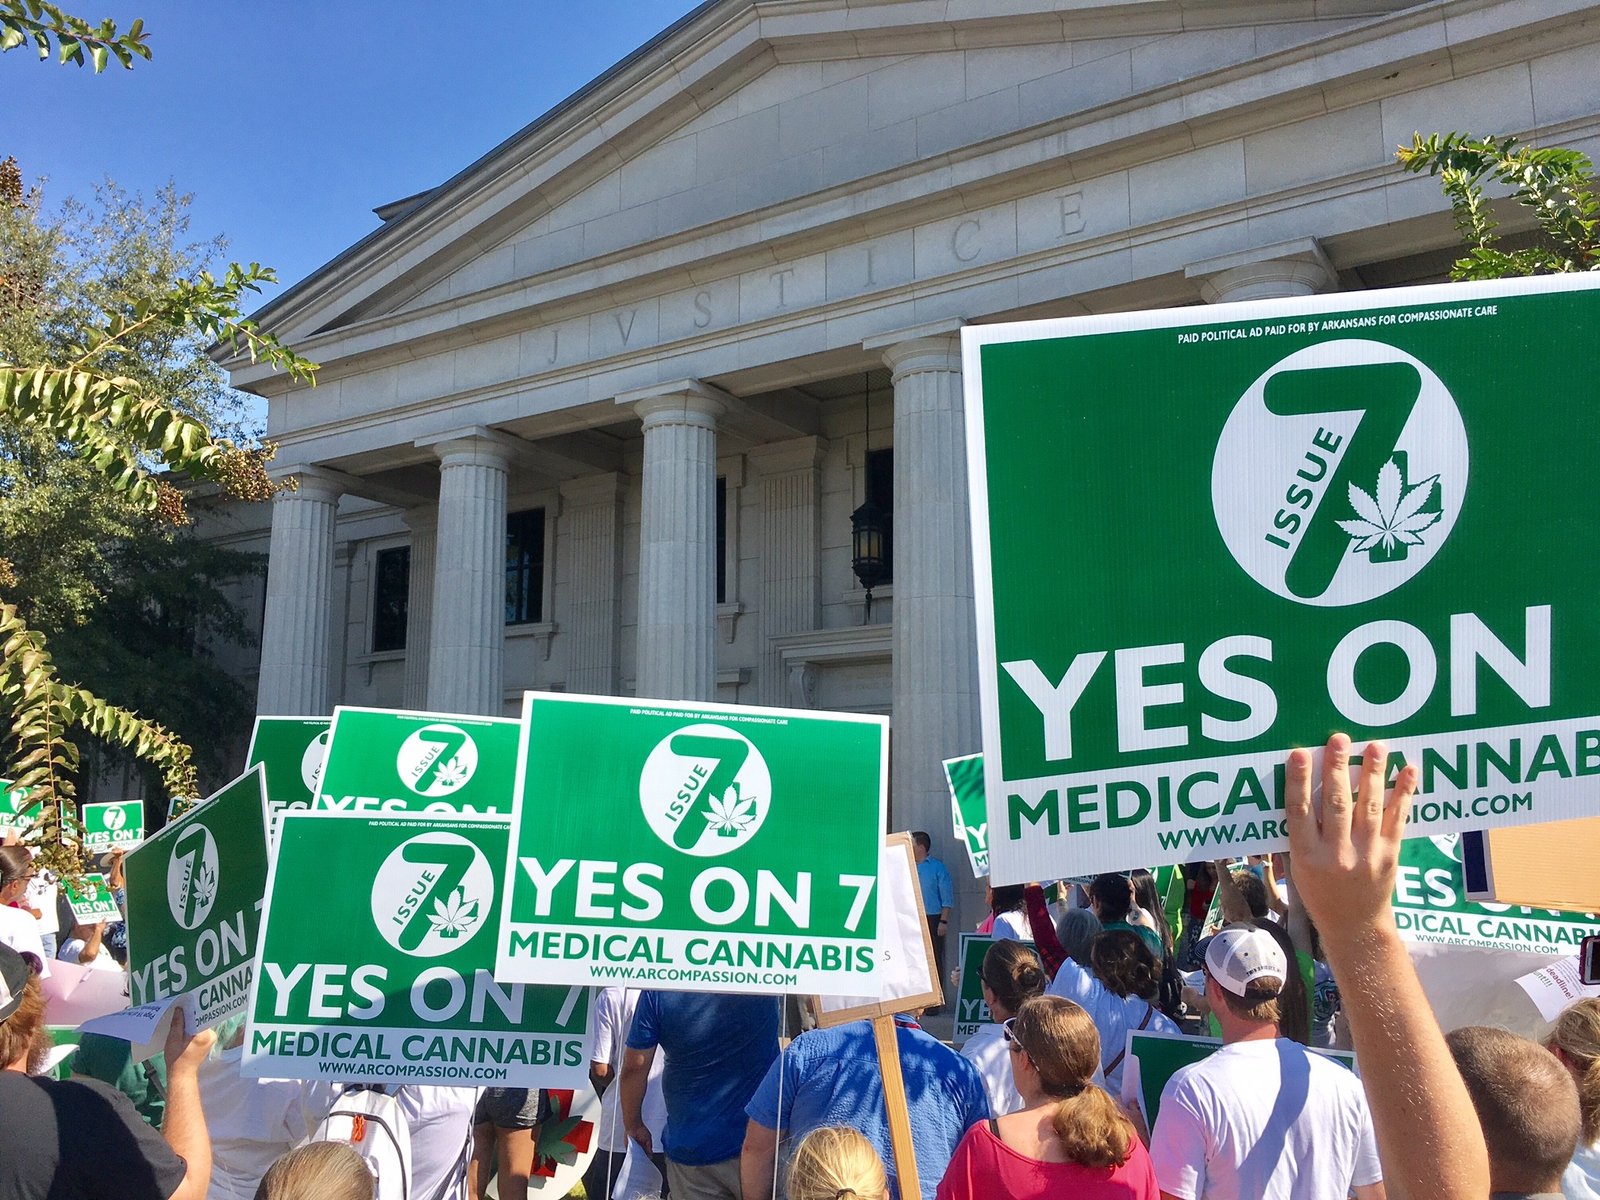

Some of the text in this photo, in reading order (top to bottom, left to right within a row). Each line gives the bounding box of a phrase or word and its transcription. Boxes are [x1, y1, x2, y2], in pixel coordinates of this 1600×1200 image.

[547, 190, 1088, 365] JVSTICE
[1178, 305, 1498, 344] PAID POLITICAL AD PAID FOR BY ARKANSANS FOR COMPASSIONATE CARE
[1264, 361, 1422, 600] 7
[1265, 426, 1344, 549] ISSUE
[1000, 604, 1552, 762] YES ON
[411, 745, 441, 778] ISSUE
[415, 730, 466, 793] 7
[664, 763, 708, 822] ISSUE
[670, 734, 749, 850] 7
[87, 827, 143, 844] YES ON 7
[72, 901, 93, 914] YES
[92, 900, 111, 912] ON
[175, 827, 206, 928] 7
[179, 859, 192, 910] ISSUE
[392, 869, 436, 926] ISSUE
[398, 842, 476, 951] 7
[518, 857, 877, 932] YES ON 7
[132, 909, 248, 1006] YES ON
[508, 930, 874, 973] MEDICAL CANNABIS
[1415, 934, 1559, 954] WWWARCOMPASSION.COM
[264, 962, 388, 1021] YES
[410, 966, 526, 1025] ON
[590, 965, 797, 986] WWW.ARCOMPASSION.COM
[251, 1029, 583, 1067] MEDICAL CANNABIS
[318, 1061, 507, 1080] WWW.ARCOMPASSION.COM
